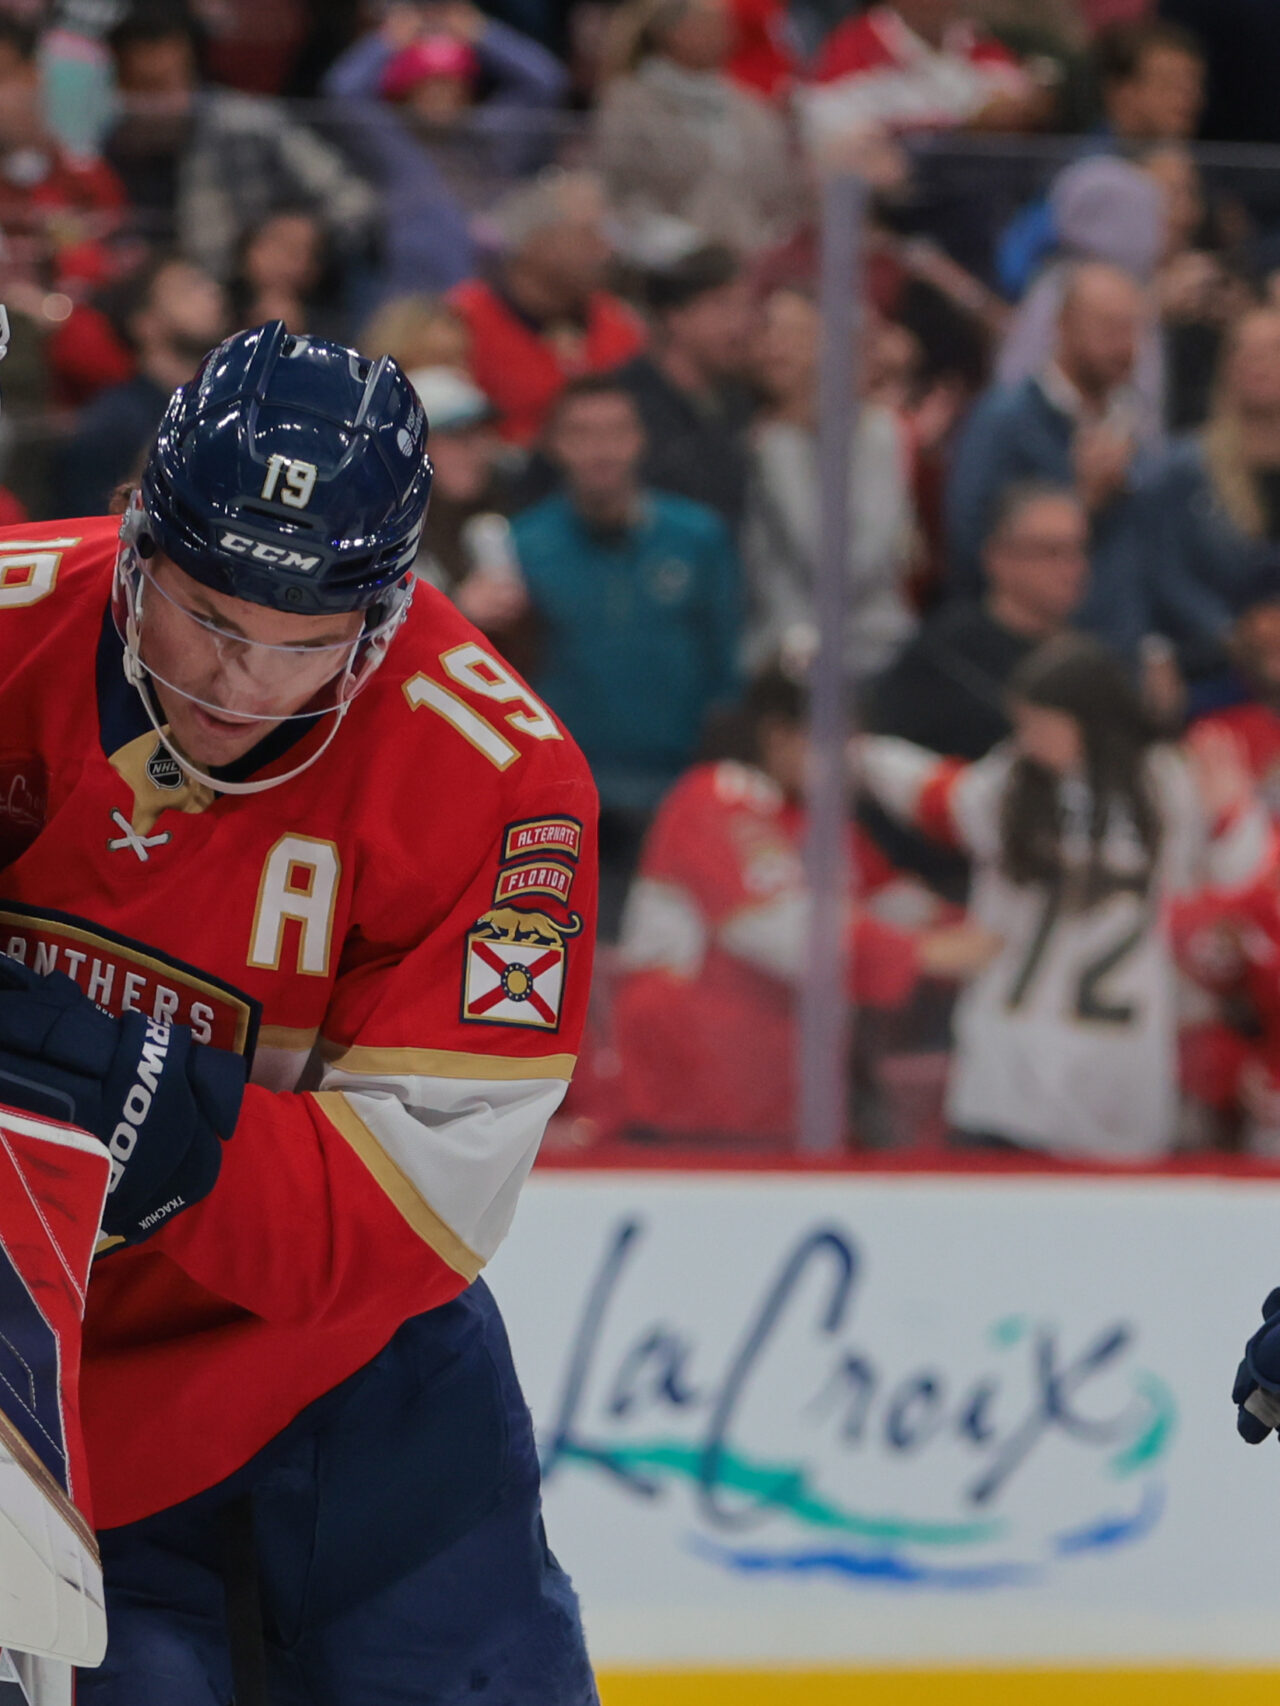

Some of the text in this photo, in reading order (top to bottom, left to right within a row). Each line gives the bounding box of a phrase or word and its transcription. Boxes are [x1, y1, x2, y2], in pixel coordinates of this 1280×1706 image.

[261, 453, 317, 509] 19
[220, 532, 320, 571] CCM
[401, 641, 564, 772] 19
[152, 762, 178, 774] NHL
[517, 826, 576, 848] ALTERNATE
[507, 868, 566, 892] FLORIDA
[246, 832, 342, 977] A
[138, 1195, 186, 1231] TKACHUK
[542, 1214, 1138, 1532] LaCroix
